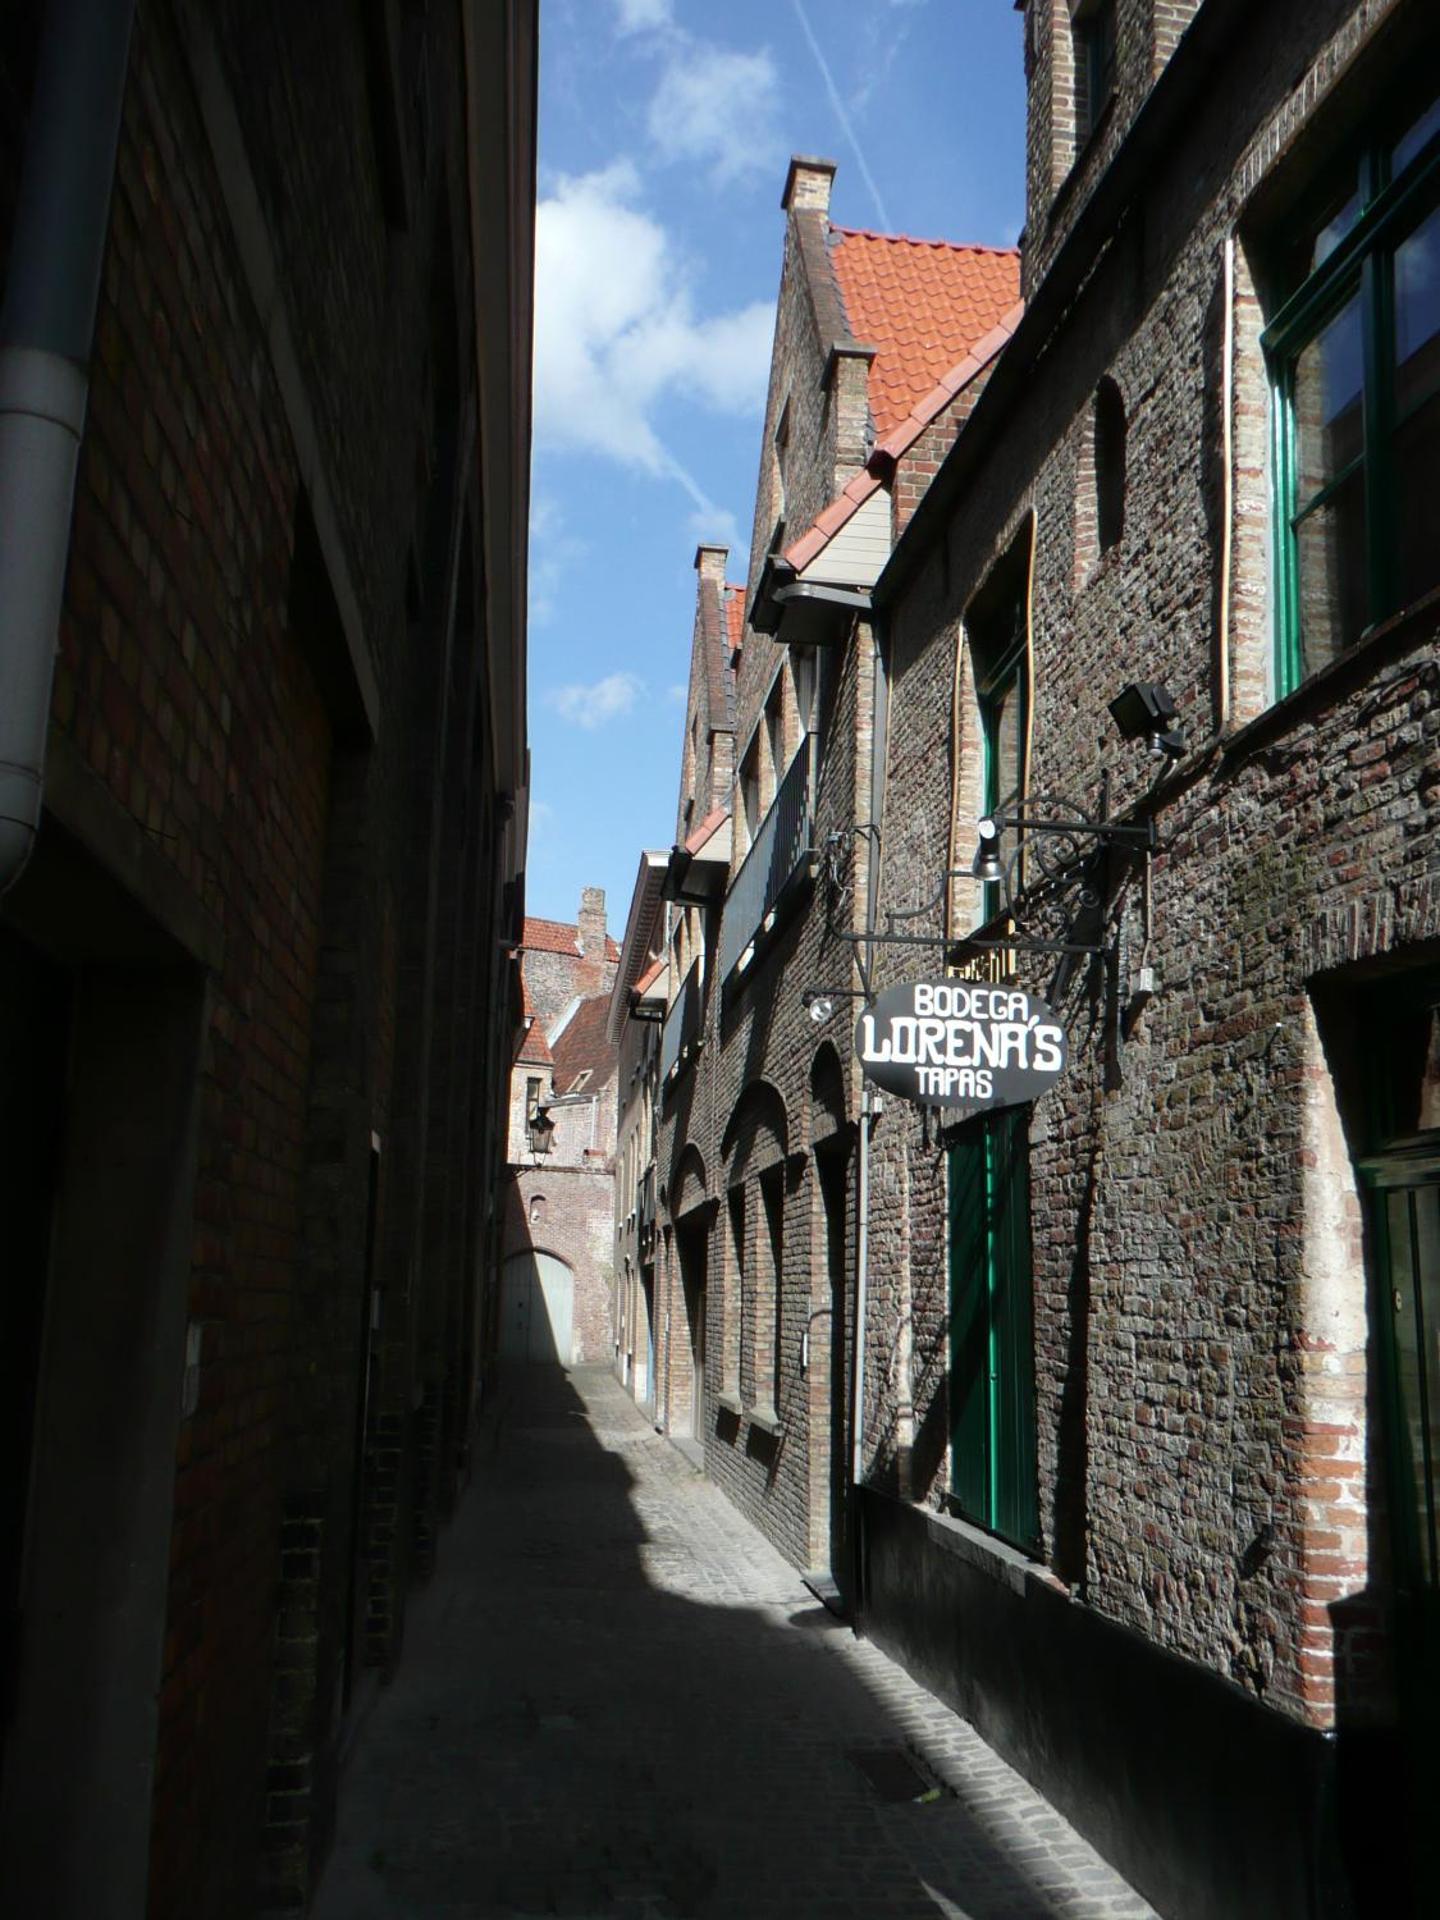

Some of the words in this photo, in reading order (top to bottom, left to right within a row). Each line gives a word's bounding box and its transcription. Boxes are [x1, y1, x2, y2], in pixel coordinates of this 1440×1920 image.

[914, 983, 1029, 1021] BODEGA
[862, 1014, 1063, 1072] LORENA'S
[914, 1066, 993, 1099] TAPAS
